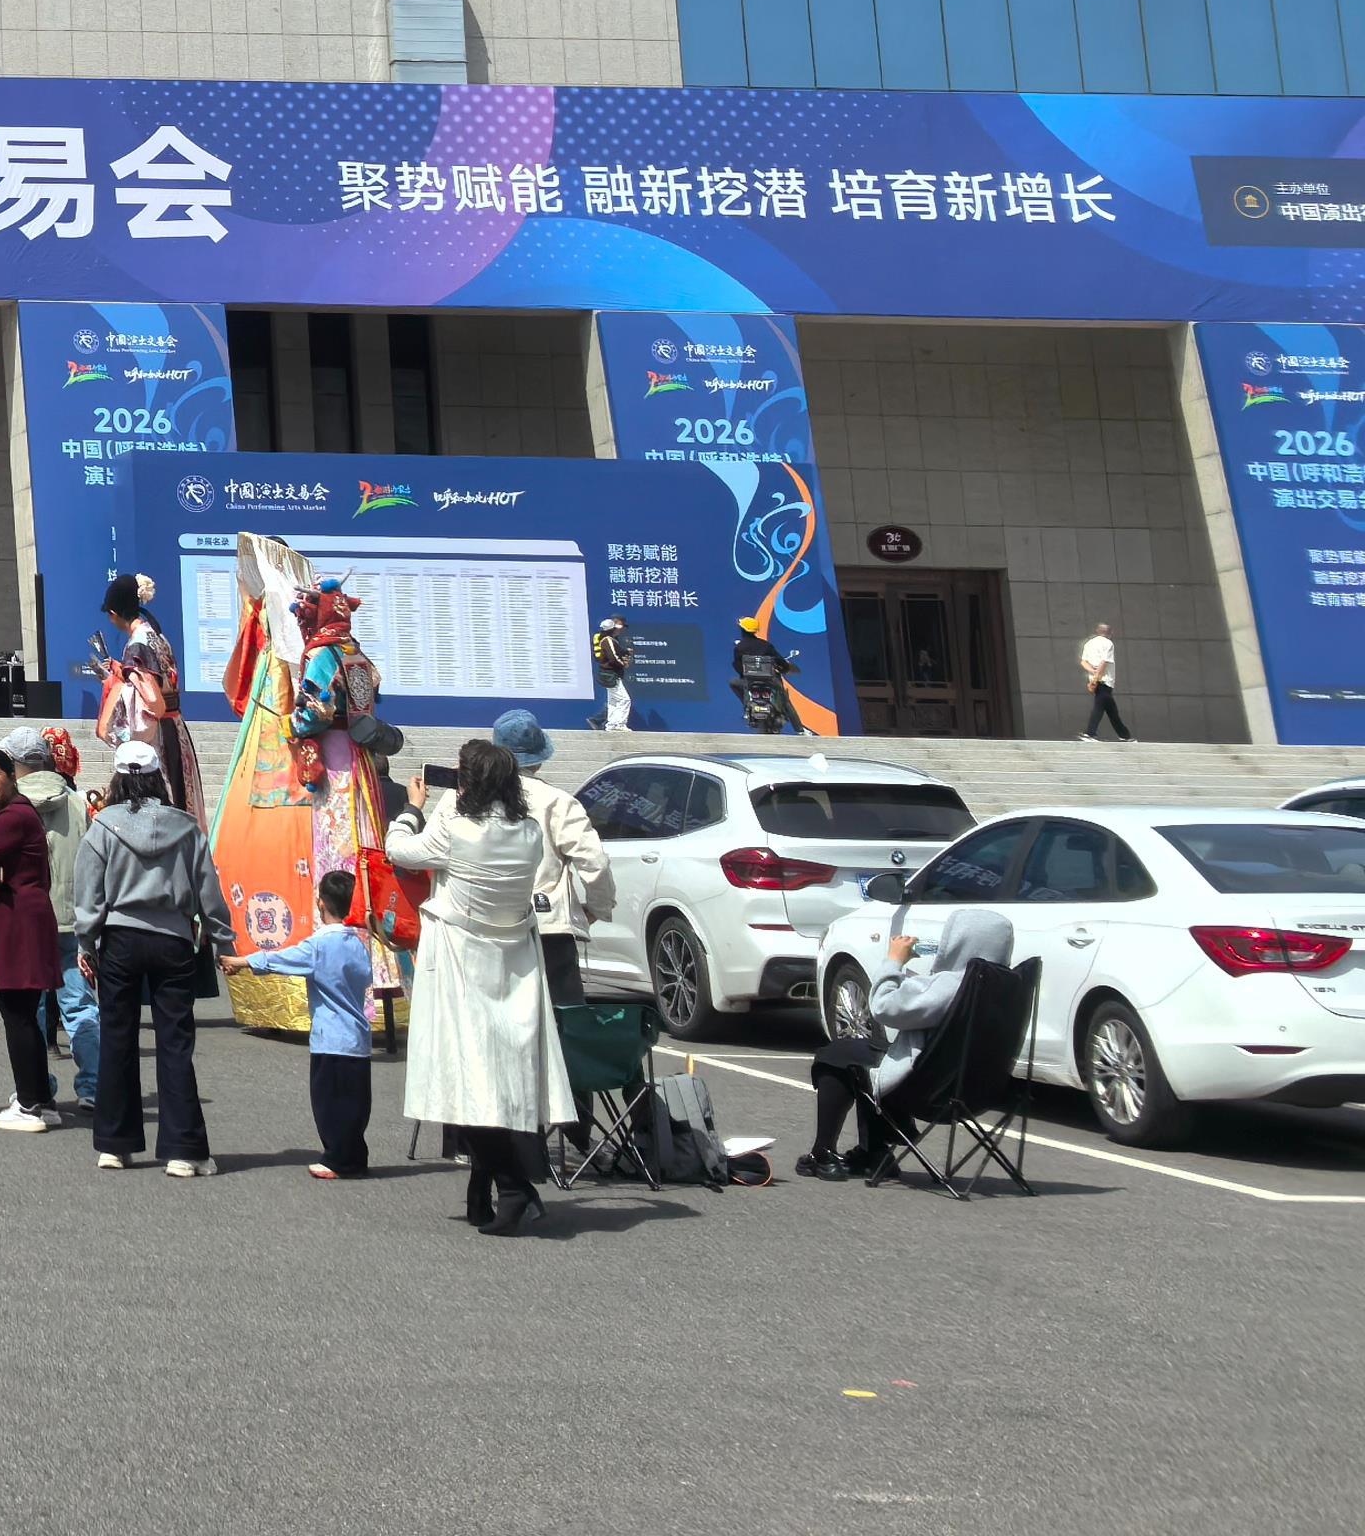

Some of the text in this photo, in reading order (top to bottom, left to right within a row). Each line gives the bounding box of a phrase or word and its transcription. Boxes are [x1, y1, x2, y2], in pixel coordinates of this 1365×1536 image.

[337, 161, 1117, 226] 聚势赋能 融新挖潜 培育新增长
[1275, 182, 1331, 195] 主办单位
[93, 408, 172, 435] 2026
[674, 417, 755, 445] 2026
[1274, 430, 1355, 457] 2026
[1248, 462, 1365, 484] 中国(呼和浩
[247, 503, 286, 511] Performing
[607, 543, 678, 562] 聚势赋能
[609, 566, 679, 584] 融新挖潜
[611, 589, 699, 608] 培育新增长
